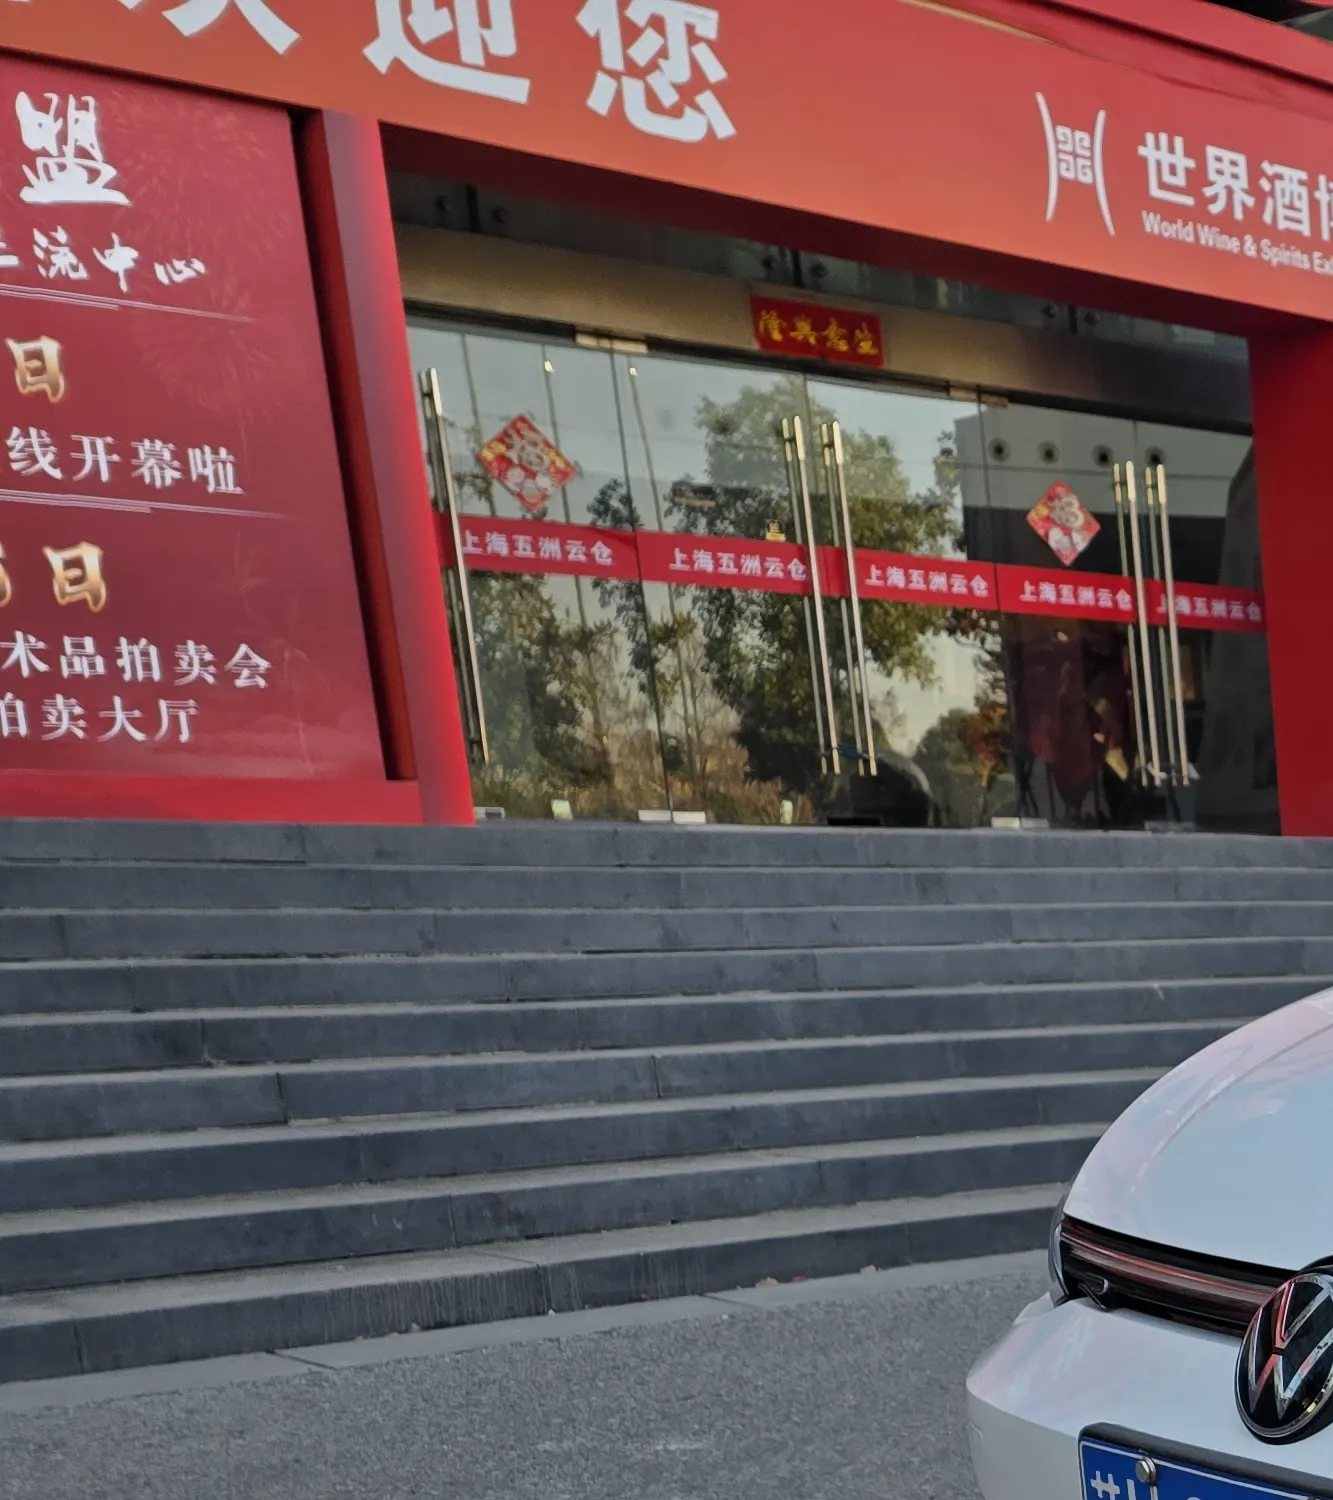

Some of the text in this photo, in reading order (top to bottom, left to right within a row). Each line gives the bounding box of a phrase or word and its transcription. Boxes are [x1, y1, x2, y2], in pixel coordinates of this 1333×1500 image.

[117, 0, 735, 142] 迎您
[15, 91, 130, 205] 盟
[1142, 210, 1195, 241] World
[1197, 223, 1240, 252] Wine
[1243, 234, 1257, 257] &
[1260, 238, 1311, 270] Spirits
[6, 336, 66, 402] 日
[6, 426, 244, 494] 线开幕啦
[462, 530, 613, 566] 上海五洲云仓
[669, 548, 808, 581] 上海五洲云仓
[864, 564, 990, 598] 上海五洲云仓
[1019, 580, 1133, 611] 上海五洲云仓
[0, 631, 271, 688] 术品拍卖会
